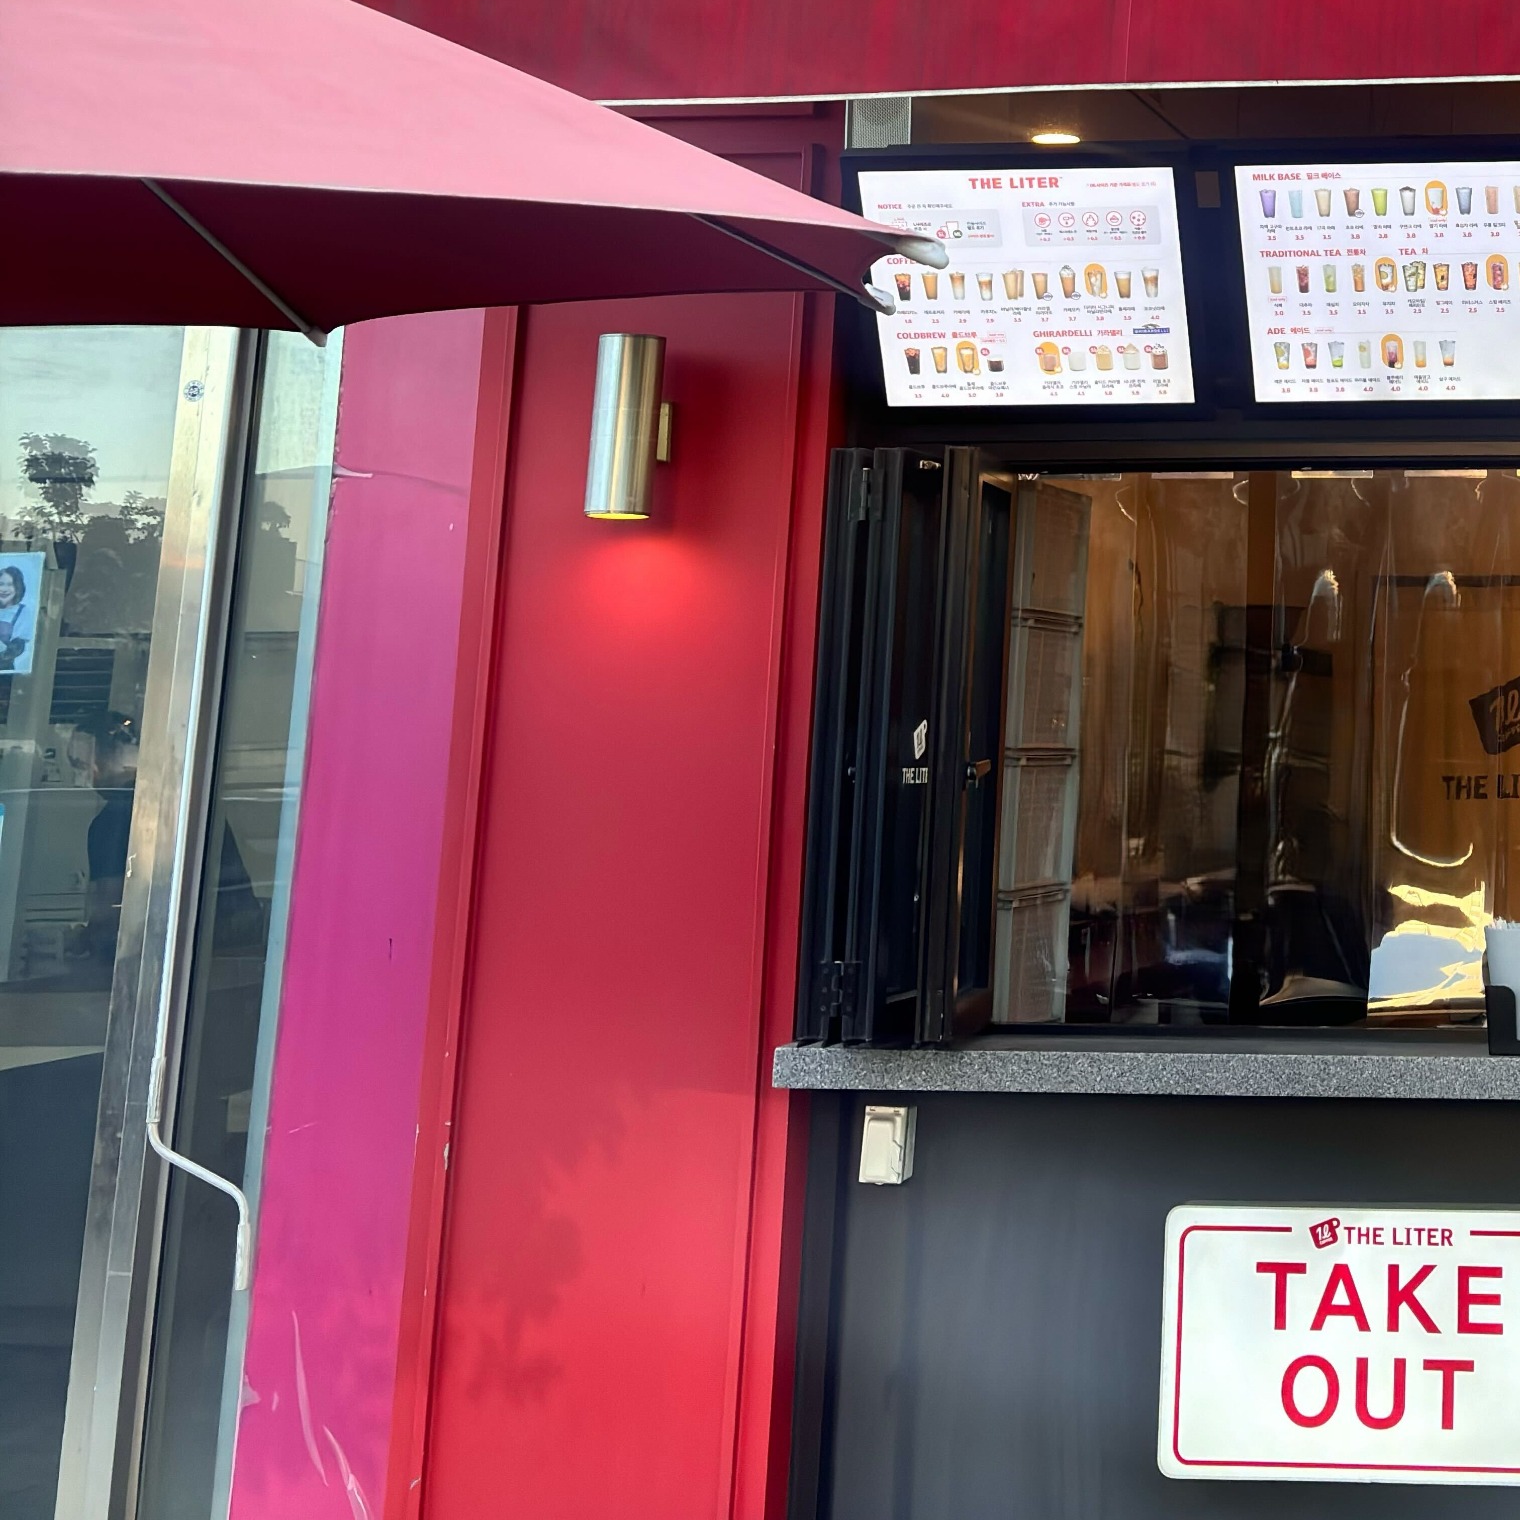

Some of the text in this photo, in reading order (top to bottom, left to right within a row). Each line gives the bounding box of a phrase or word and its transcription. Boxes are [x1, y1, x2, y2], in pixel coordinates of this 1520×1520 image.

[1252, 173, 1276, 181] MILK
[1277, 173, 1302, 181] BASE
[968, 176, 1060, 190] THE LITER
[1260, 249, 1322, 258] TRADITIONAL
[1323, 249, 1342, 257] TEA
[1398, 247, 1417, 256] TEA
[896, 332, 947, 340] COLDBREW
[1033, 329, 1093, 338] GHIRARDELLI
[1267, 327, 1287, 336] ADE
[1441, 775, 1489, 800] THE
[1343, 1226, 1454, 1247] THE LITER
[1255, 1261, 1505, 1336] TAKE
[1279, 1354, 1476, 1431] OUT
